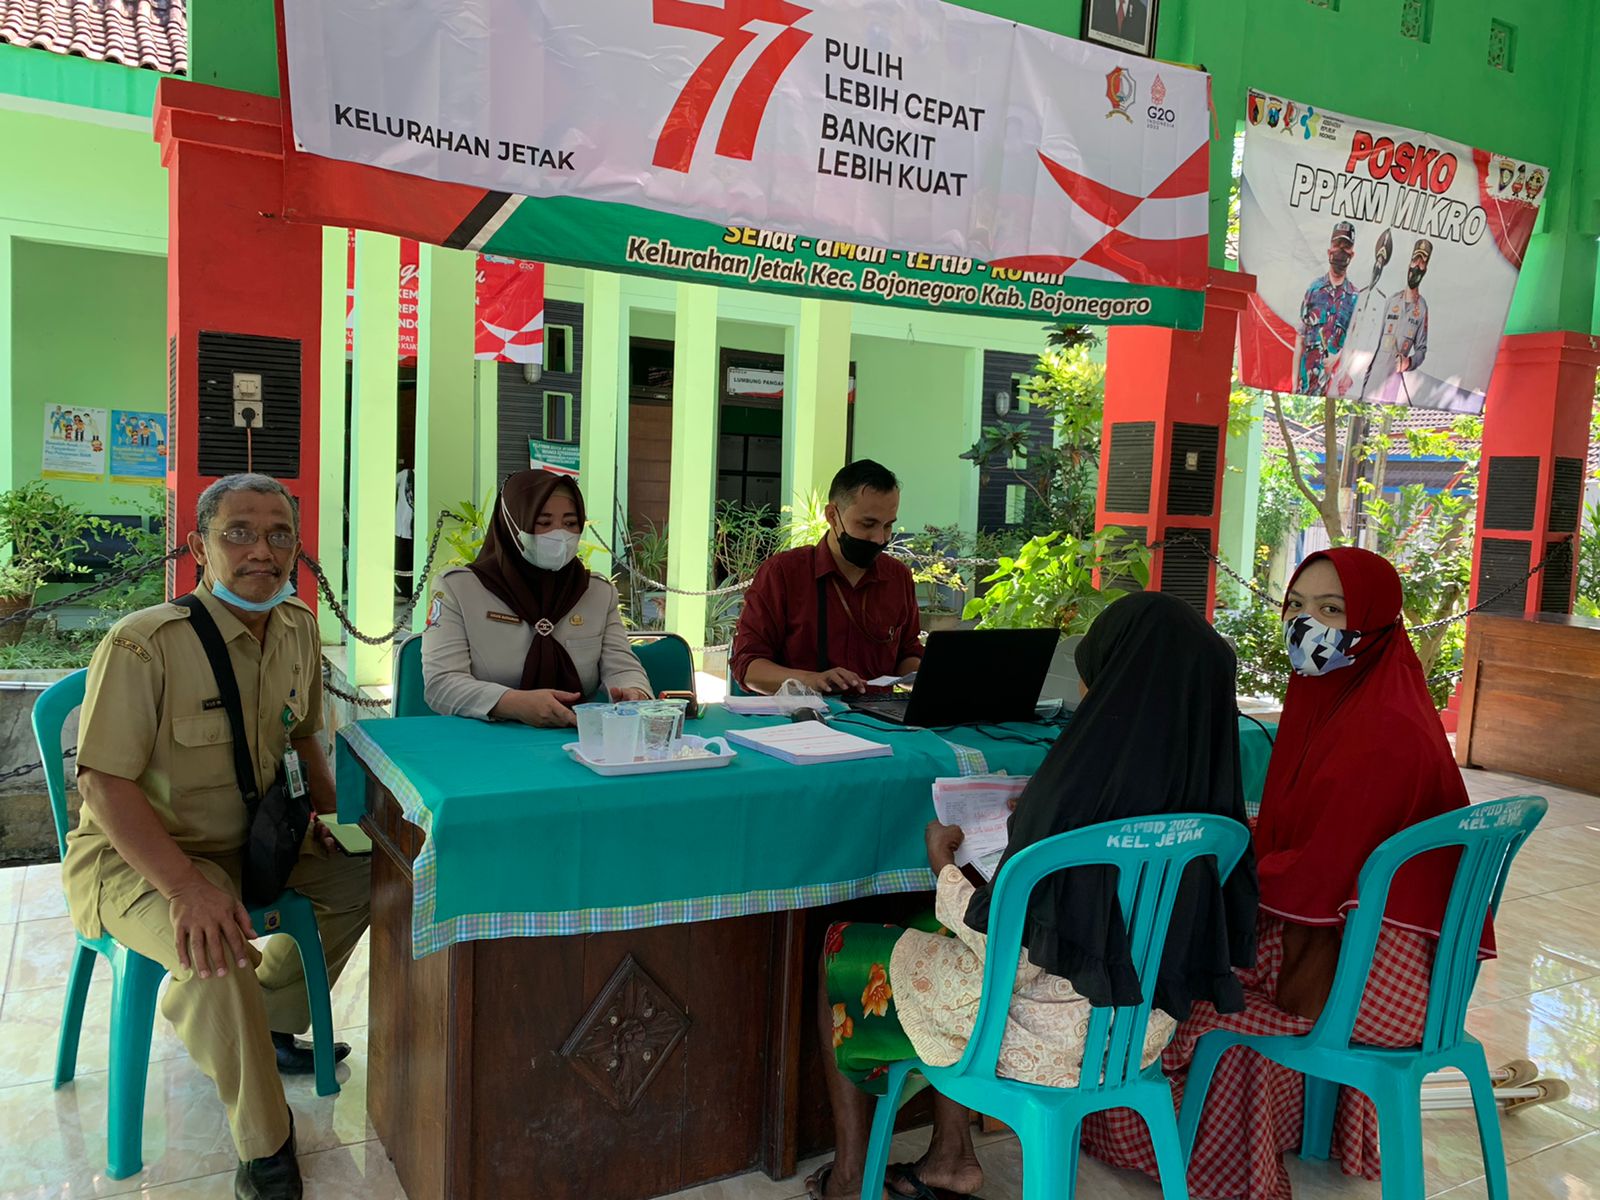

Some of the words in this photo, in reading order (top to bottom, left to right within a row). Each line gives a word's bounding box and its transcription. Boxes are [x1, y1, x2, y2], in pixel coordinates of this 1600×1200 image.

[825, 37, 903, 81] PULIH
[825, 73, 899, 115] LEBIH
[904, 93, 986, 132] CEPAT
[1147, 105, 1175, 122] G20
[334, 103, 490, 158] KELURAHAN
[497, 140, 575, 170] JETAK
[821, 113, 936, 161] BANGKIT
[817, 147, 893, 186] LEBIH
[898, 163, 968, 197] KUAT
[1345, 130, 1458, 195] POSKO
[1290, 163, 1390, 224] PPKM
[626, 236, 750, 276] Kelurahan
[749, 252, 808, 284] Jetak
[808, 262, 856, 289] Kec.
[860, 268, 978, 305] Bojonegoro
[979, 283, 1026, 309] Kab.
[1029, 288, 1152, 320] Bojonegoro
[1106, 834, 1150, 849] KEL.
[1155, 827, 1205, 848] JETAK
[1458, 817, 1490, 831] KEL.
